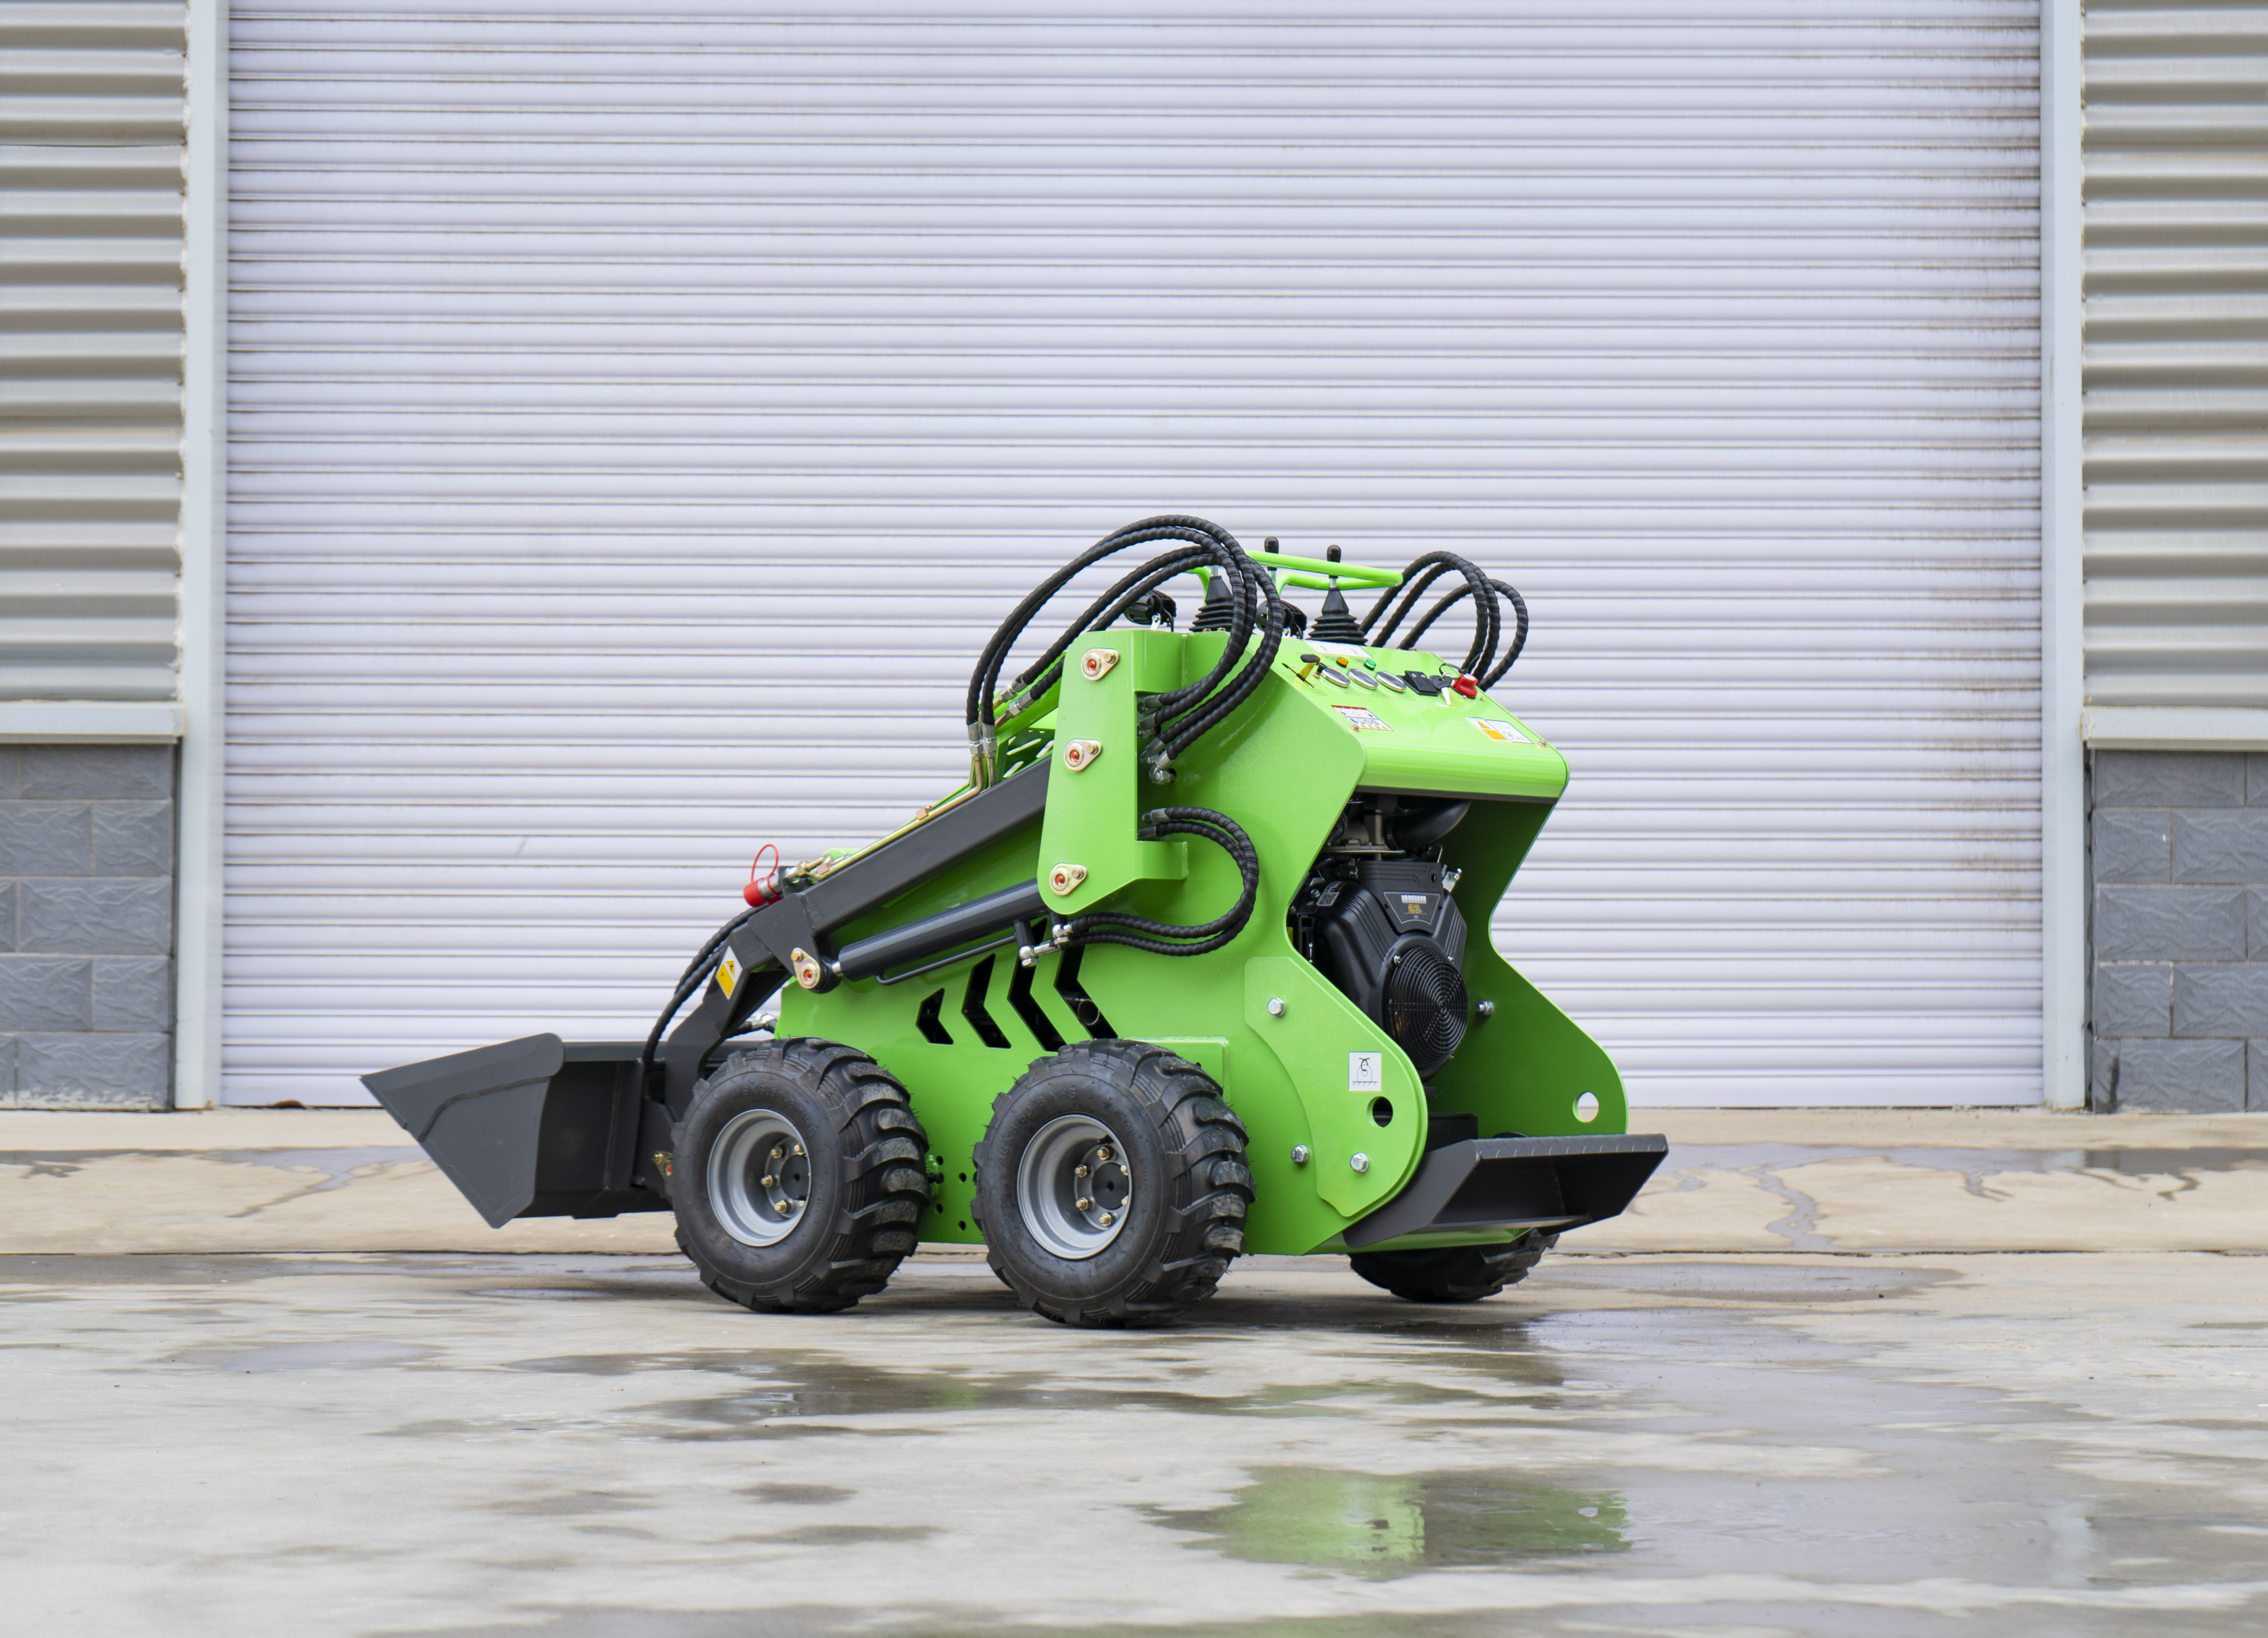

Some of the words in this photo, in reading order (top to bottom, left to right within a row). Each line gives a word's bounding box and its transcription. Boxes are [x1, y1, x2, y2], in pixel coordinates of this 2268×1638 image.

[1401, 894, 1426, 904] VANGUARD
[1408, 904, 1420, 913] 23
[1049, 1087, 1076, 1102] NHS
[1113, 1108, 1134, 1136] NYLON
